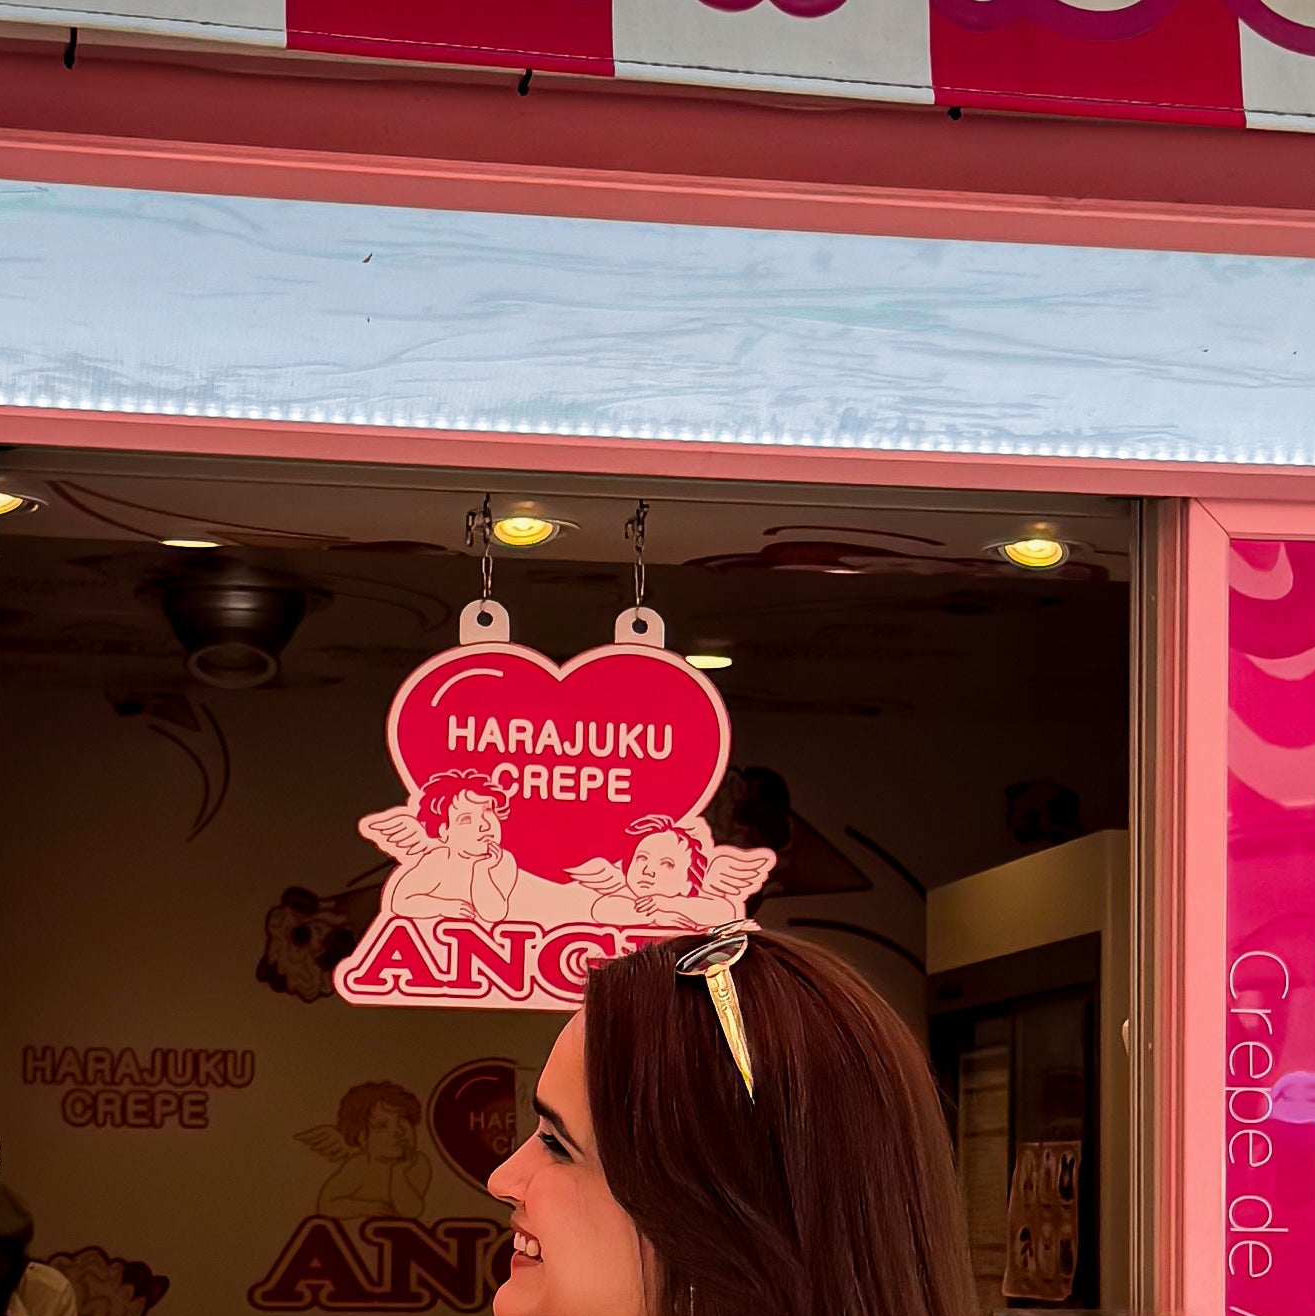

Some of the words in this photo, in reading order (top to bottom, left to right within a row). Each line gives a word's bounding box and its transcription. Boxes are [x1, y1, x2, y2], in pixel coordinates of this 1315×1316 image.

[447, 714, 673, 760] HARAJUKU
[491, 762, 633, 803] CREPE
[343, 914, 668, 1001] ANG
[22, 1046, 255, 1088] HARAJUKU
[1226, 950, 1290, 1168] Crepe
[62, 1090, 209, 1129] CREPE
[1228, 1194, 1289, 1279] de
